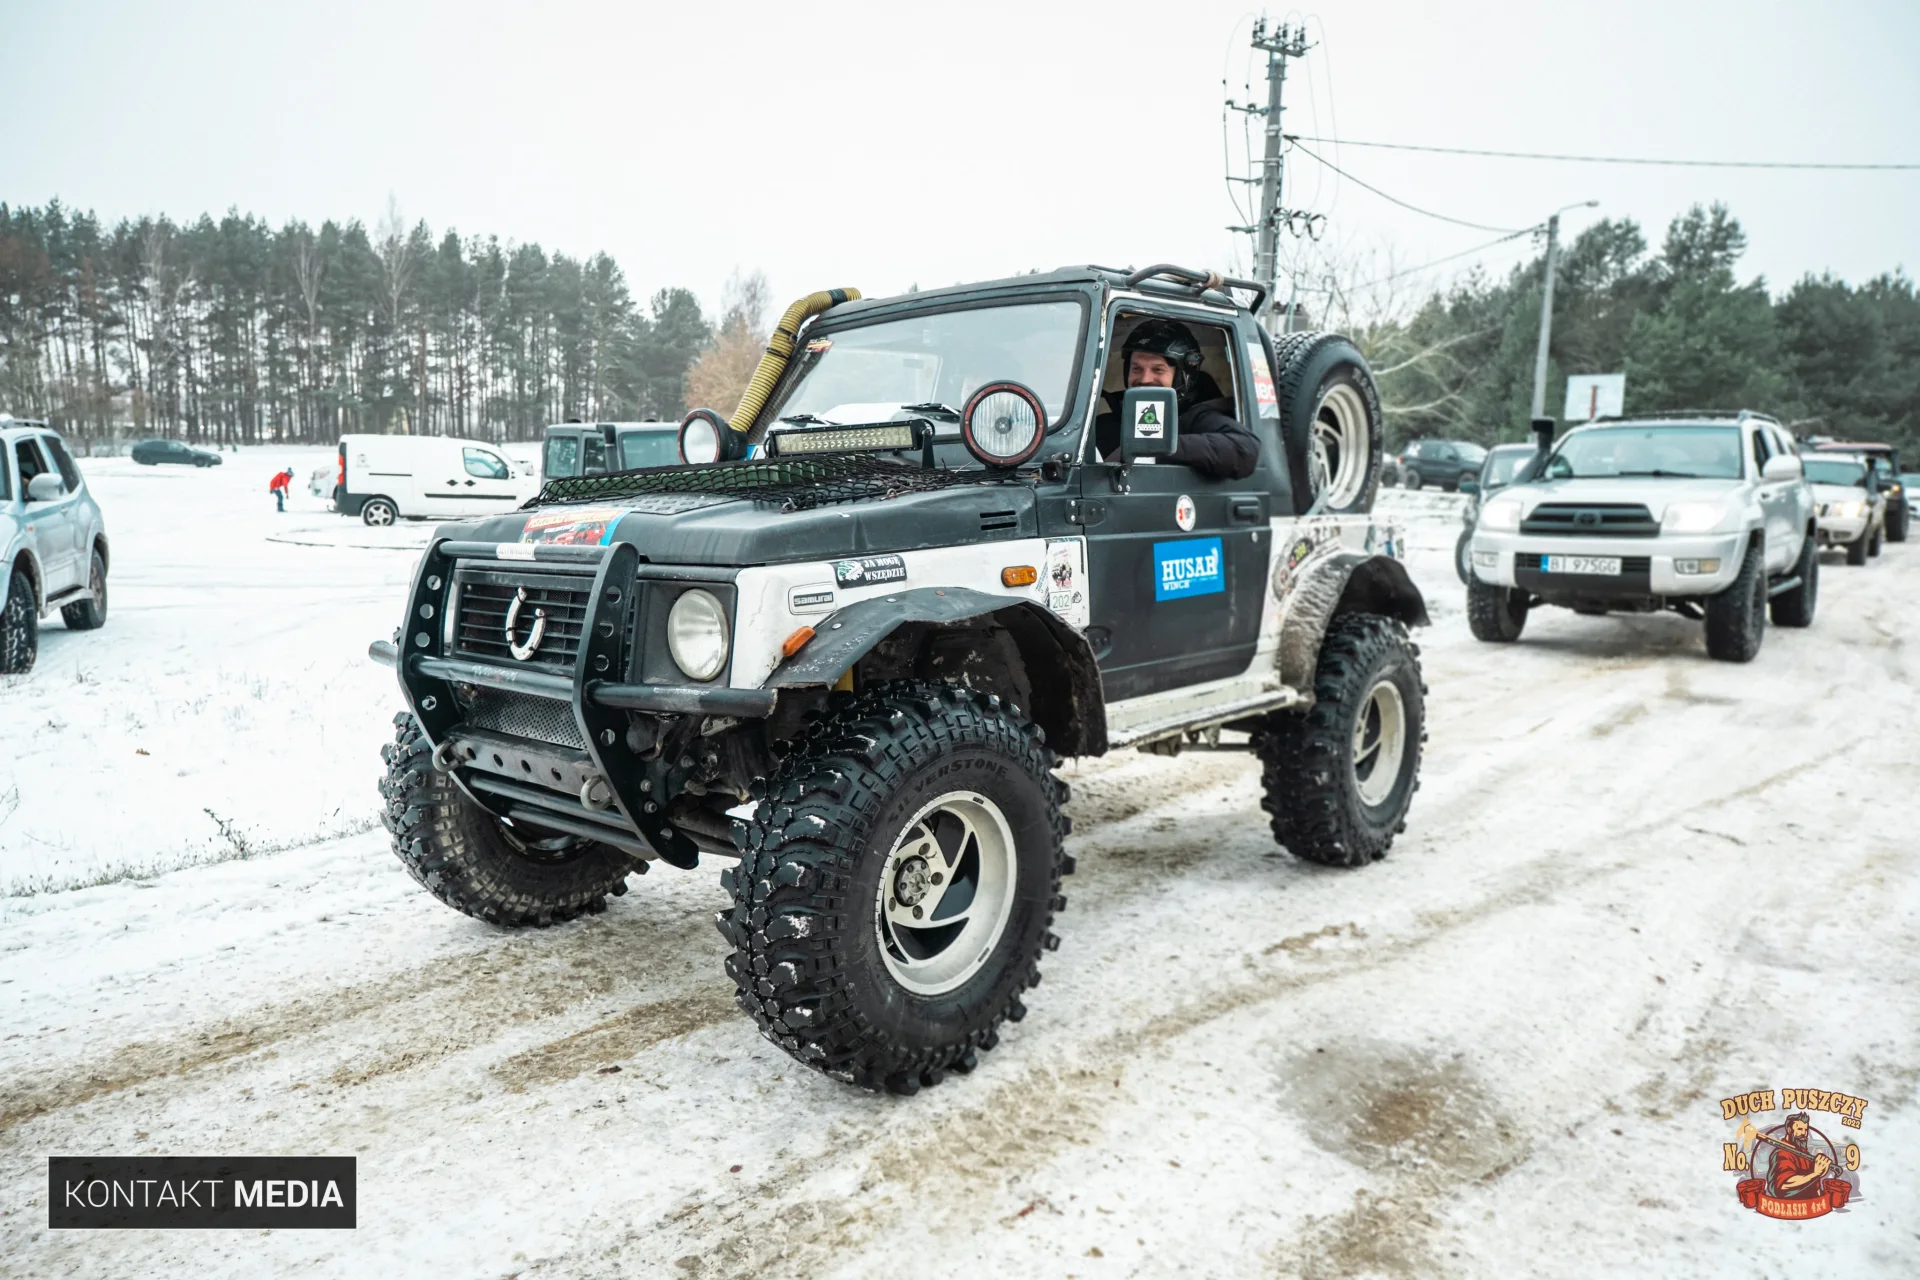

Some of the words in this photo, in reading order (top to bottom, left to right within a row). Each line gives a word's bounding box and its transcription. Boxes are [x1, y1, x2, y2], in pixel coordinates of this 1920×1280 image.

[864, 560, 876, 569] JA
[877, 556, 901, 567] MOGĘ
[1161, 554, 1218, 582] HUSAR
[864, 567, 905, 581] WSZĘDZIE
[1163, 580, 1190, 591] WINCH
[794, 593, 833, 605] samurai
[1052, 595, 1070, 609] 202
